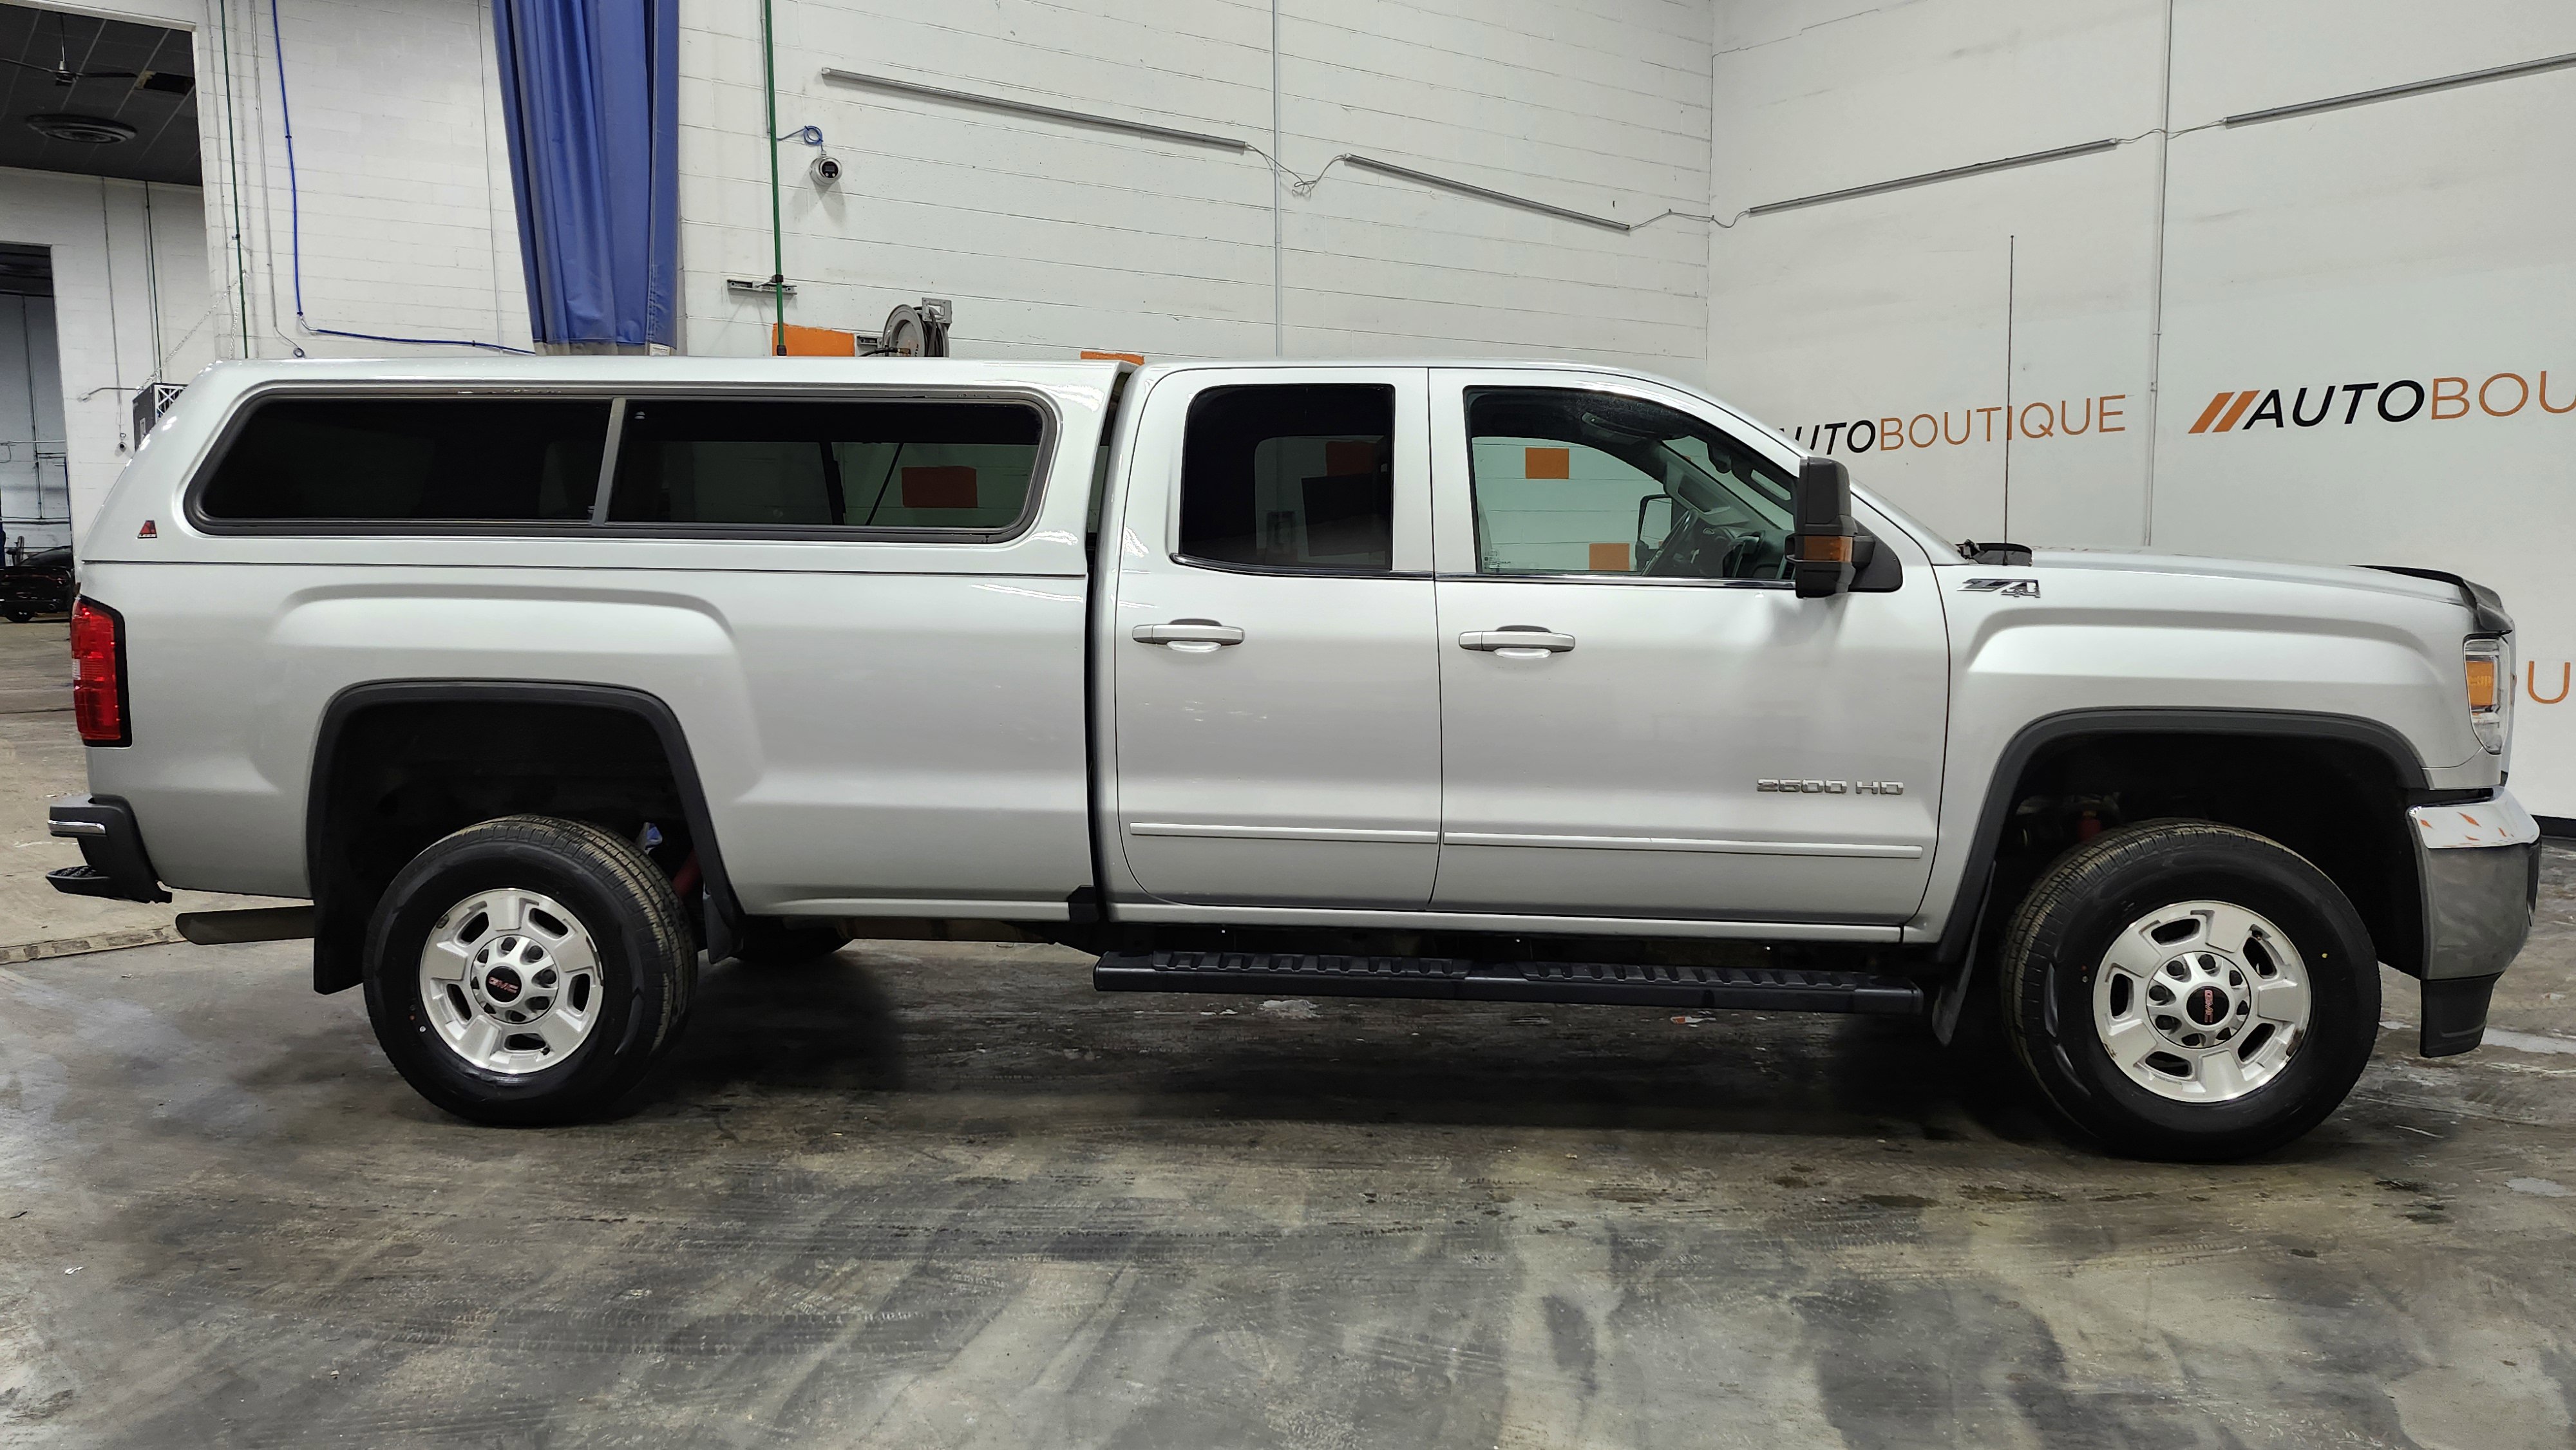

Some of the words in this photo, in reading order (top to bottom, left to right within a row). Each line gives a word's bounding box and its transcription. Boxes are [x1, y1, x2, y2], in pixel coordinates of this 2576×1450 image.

[1779, 394, 2126, 455] UTOBOUTIQUE
[1757, 778, 1848, 793] 2500
[1855, 780, 1904, 795] HD
[489, 976, 518, 993] GMC
[2204, 990, 2213, 1023] GMC
